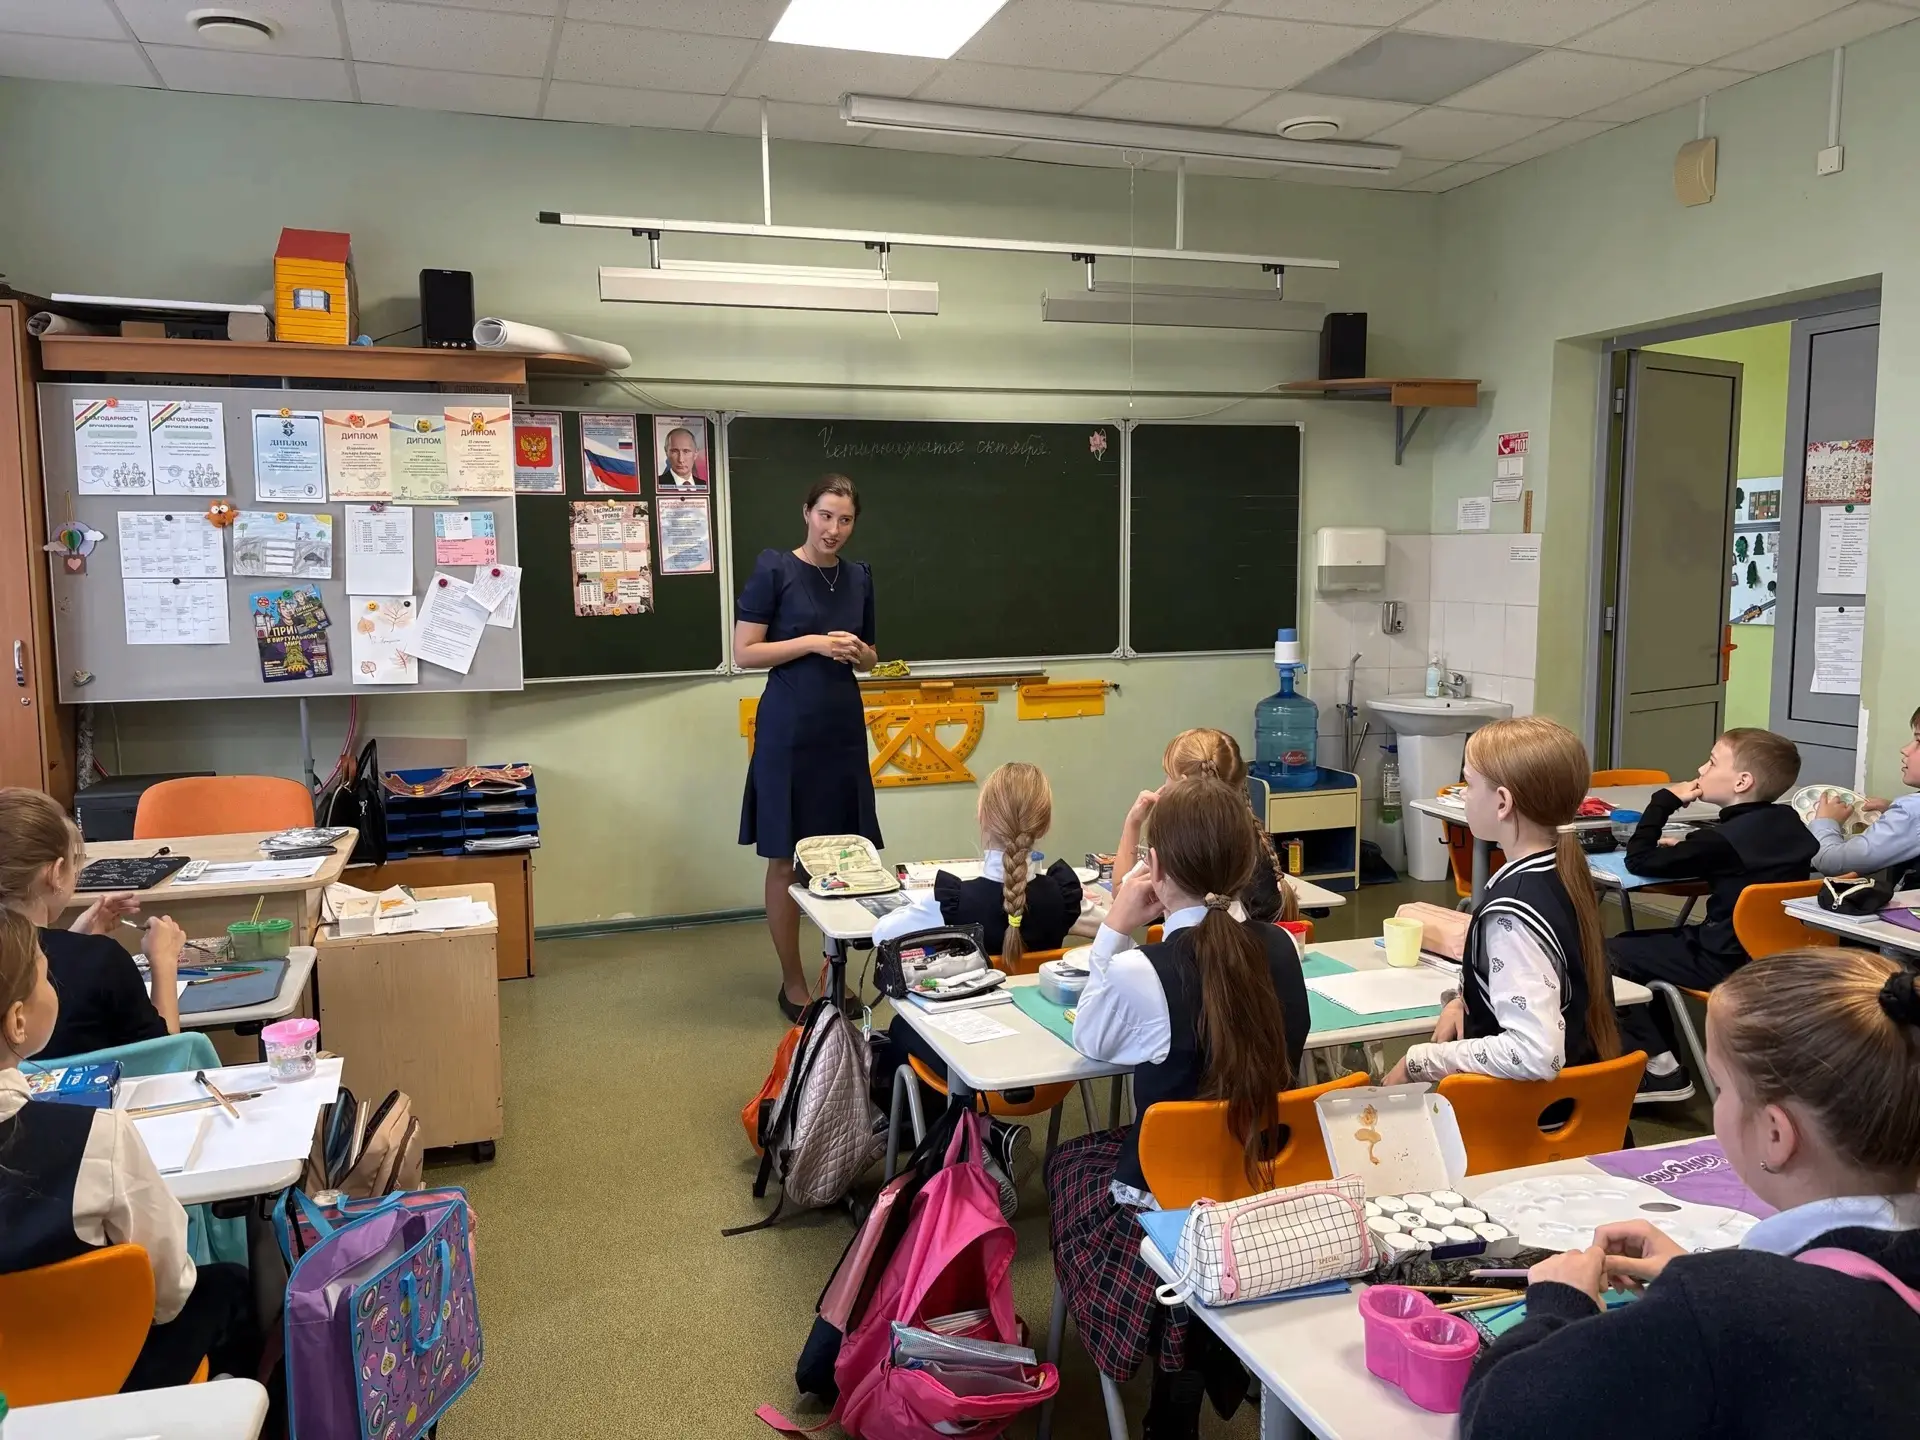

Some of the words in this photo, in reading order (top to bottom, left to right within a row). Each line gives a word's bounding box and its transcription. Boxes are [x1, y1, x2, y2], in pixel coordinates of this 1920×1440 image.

[461, 429, 496, 437] ДИПЛОМ
[406, 437, 442, 445] ДИПЛОМ
[1516, 440, 1528, 452] 101
[593, 506, 624, 514] РАСПИСАНИЕ
[272, 626, 298, 637] ПРИ
[272, 633, 318, 643] ВИРТУАЛЬНОМ
[1319, 1256, 1340, 1265] SPECIAL
